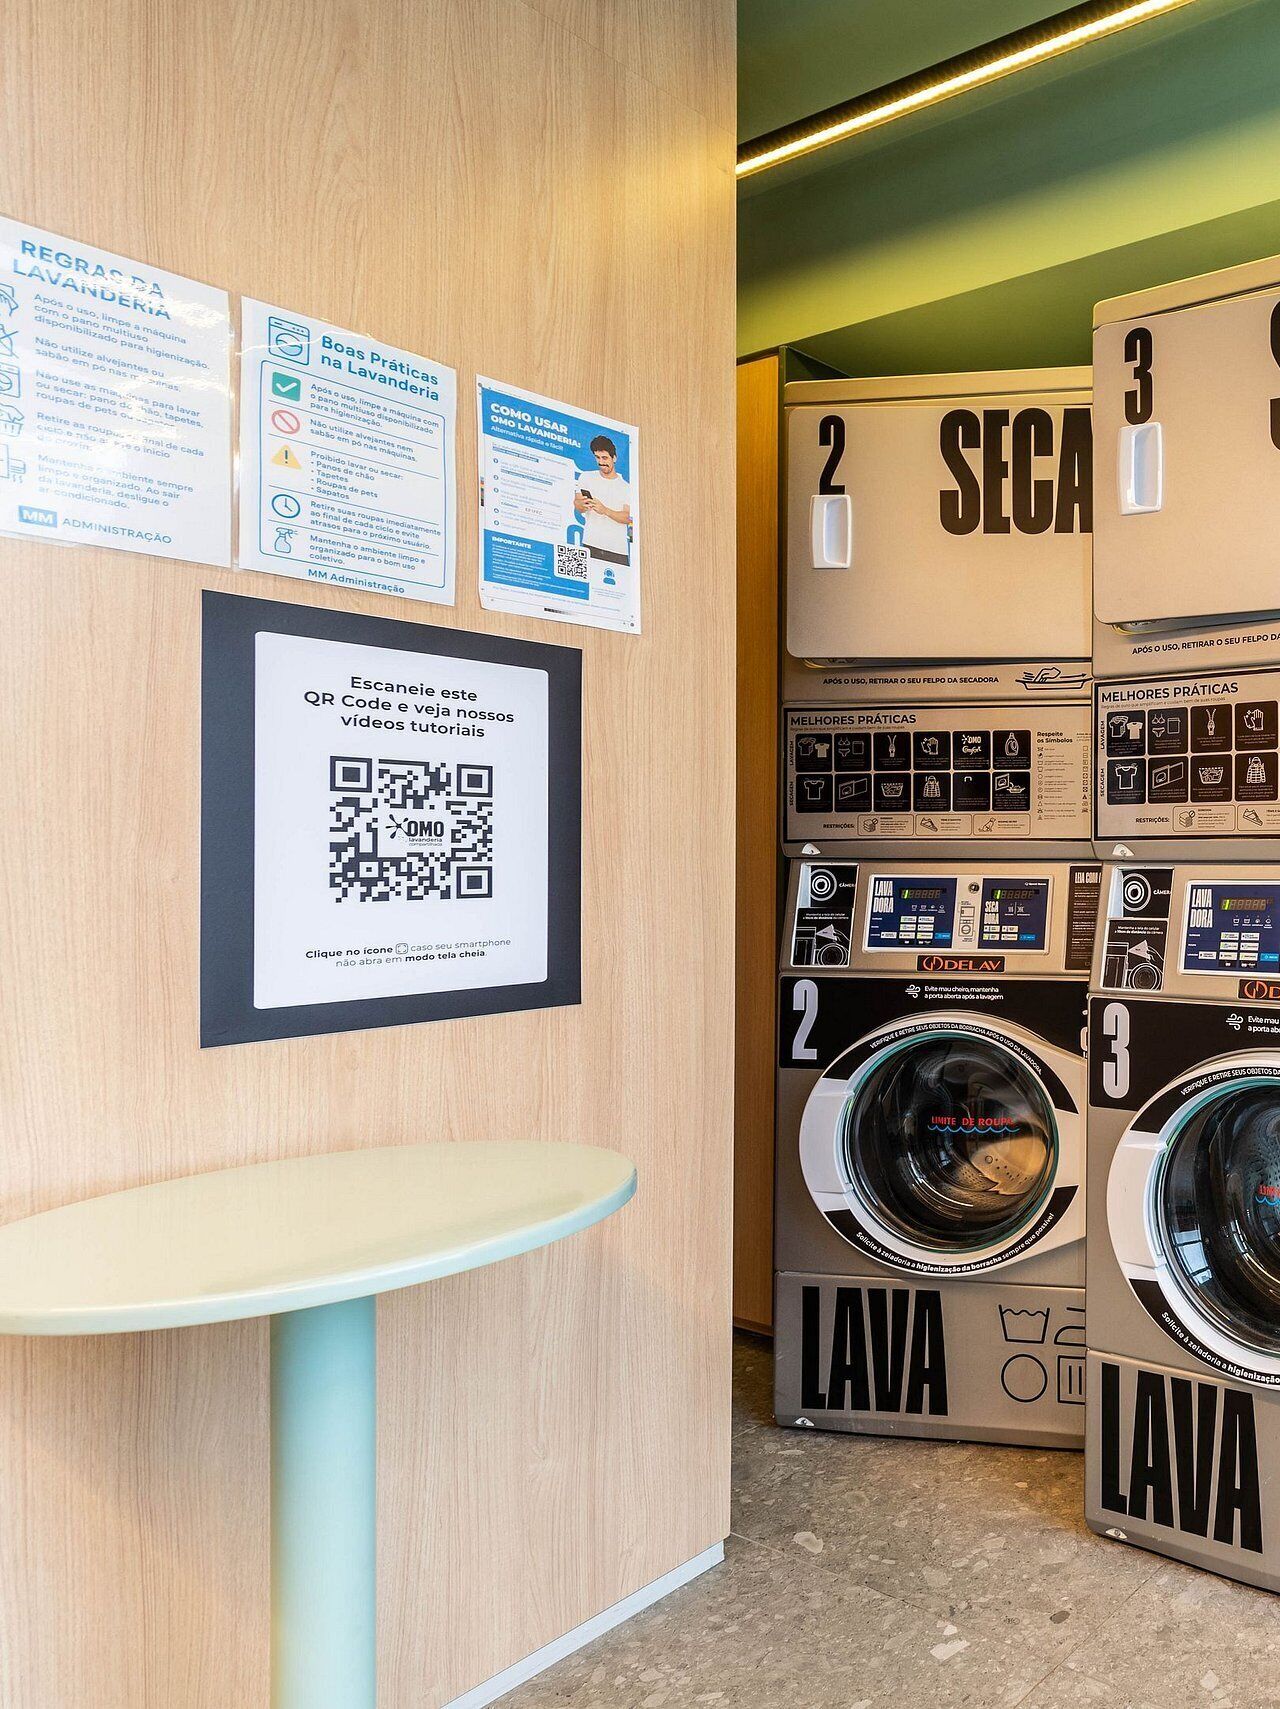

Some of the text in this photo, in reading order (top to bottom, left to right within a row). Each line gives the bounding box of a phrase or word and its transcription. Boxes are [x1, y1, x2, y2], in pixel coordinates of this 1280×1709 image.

[21, 240, 123, 285] REGRAS
[14, 259, 171, 320] LAVANDERIA
[322, 335, 438, 385] Boas Práticas
[321, 354, 439, 401] na Lavanderia
[1124, 327, 1152, 425] 3
[310, 384, 332, 395] Após
[341, 394, 357, 404] uso,
[360, 398, 380, 410] limpe
[390, 408, 421, 423] máquina
[423, 420, 439, 428] com
[491, 403, 568, 434] COMO USAR
[491, 415, 581, 448] OMO LAVANDERIA:
[819, 415, 845, 495] 2
[939, 408, 1093, 535] SECA
[22, 510, 172, 544] MM ADMINISTRAÇÃO
[492, 536, 532, 549] IMPORTANTE
[308, 569, 404, 593] MM Administração
[1132, 646, 1152, 655] APÓS
[1162, 644, 1180, 652] USO,
[1182, 640, 1215, 649] RETIRAR
[1224, 637, 1240, 645] SEU
[1242, 634, 1268, 643] FELPO
[351, 676, 478, 701] Escaneie este
[823, 677, 842, 685] APÓS
[1101, 682, 1238, 702] MELHORES PRÁTICAS
[304, 691, 515, 723] QR Code e veja nossos
[341, 714, 485, 738] vídeos tutoriais
[790, 713, 916, 726] MELHORES PRÁTICAS
[407, 821, 444, 837] OMO
[1136, 816, 1169, 824] RESTRIÇÕES:
[874, 881, 893, 896] LAVA
[1191, 888, 1212, 908] LAVA
[873, 897, 894, 913] DORA
[985, 901, 999, 913] SECA
[984, 913, 999, 925] DORA
[1190, 909, 1212, 928] DORA
[306, 949, 342, 959] Clique
[346, 948, 360, 956] no
[364, 946, 393, 955] ícone
[410, 944, 433, 952] caso
[454, 938, 511, 949] smartphone
[336, 958, 356, 967] não
[359, 957, 383, 966] abra
[386, 956, 402, 964] em
[405, 953, 435, 962] modo
[438, 951, 456, 960] tela
[942, 959, 1002, 971] DELAV
[792, 979, 818, 1060] 2
[1103, 1003, 1130, 1099] 3
[931, 1116, 956, 1125] LIMITE
[962, 1118, 974, 1126] DE
[801, 1286, 948, 1416] LAVA
[1162, 1311, 1185, 1338] Solicite
[1184, 1335, 1190, 1343] à
[1189, 1340, 1222, 1368] zeladoria
[1227, 1365, 1280, 1385] higienização
[1101, 1362, 1263, 1554] LAVA
